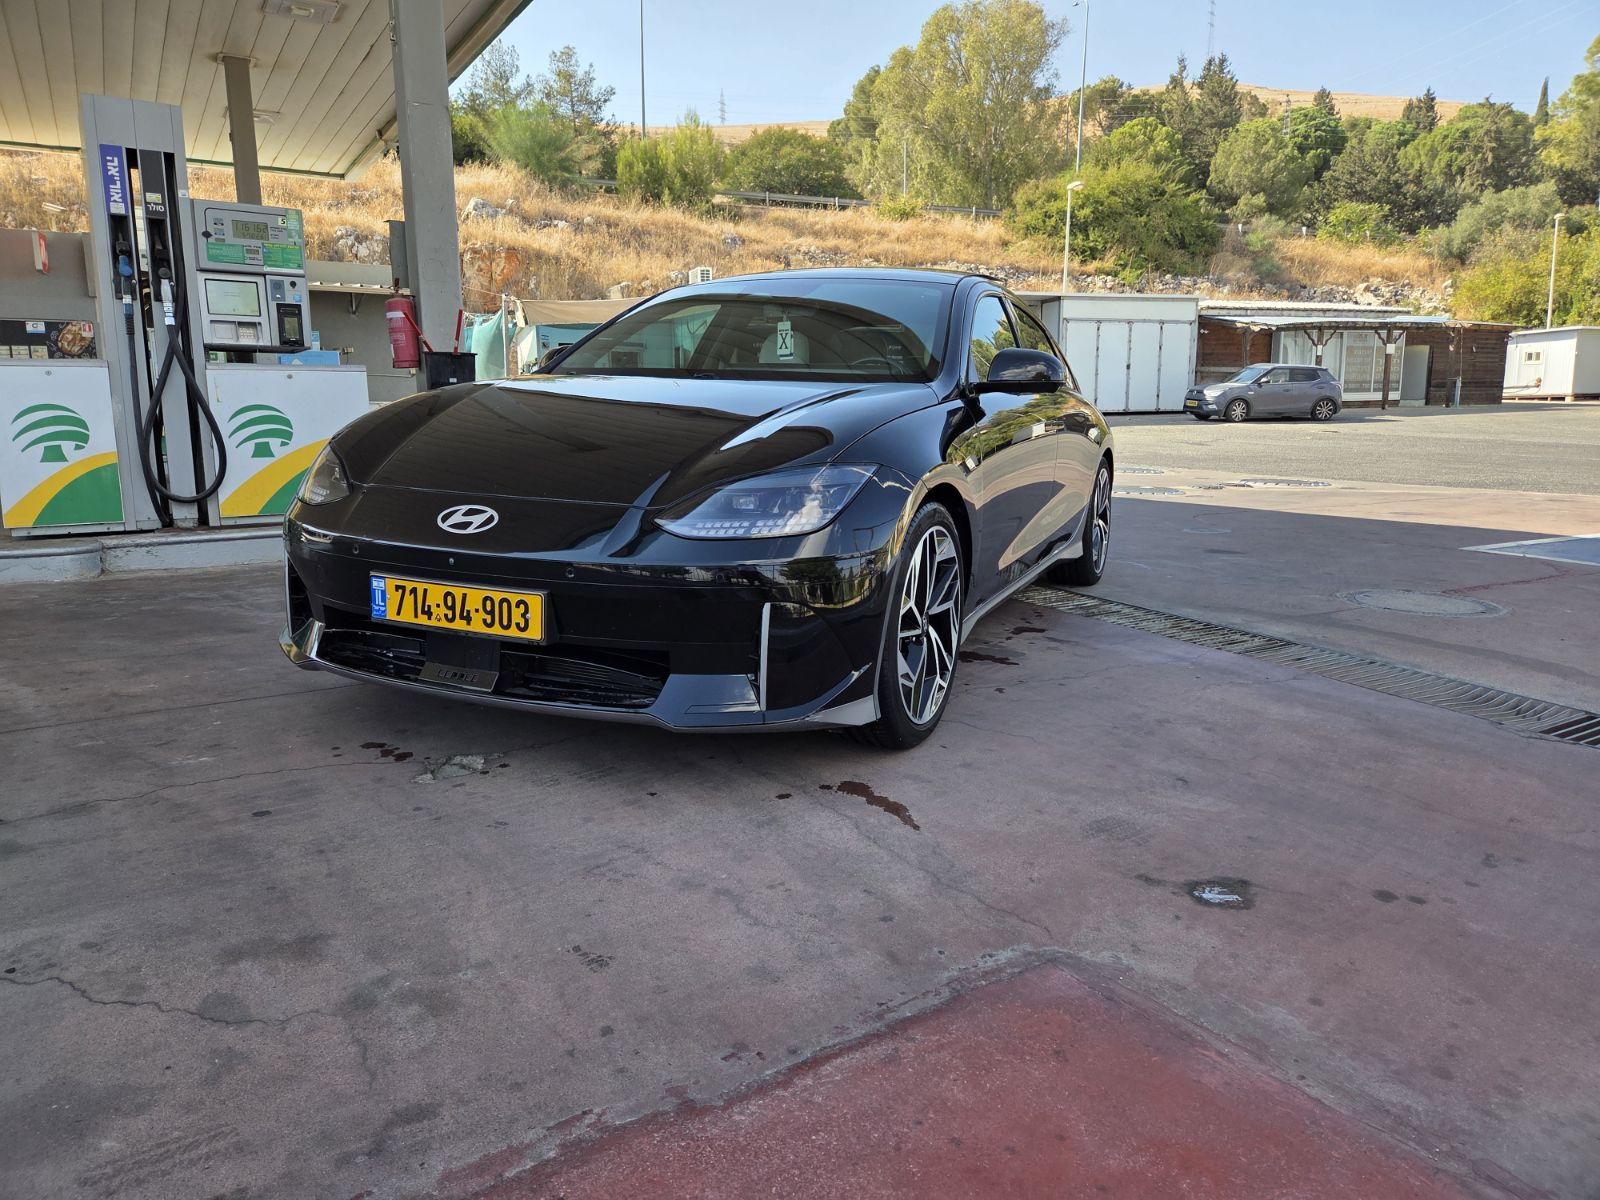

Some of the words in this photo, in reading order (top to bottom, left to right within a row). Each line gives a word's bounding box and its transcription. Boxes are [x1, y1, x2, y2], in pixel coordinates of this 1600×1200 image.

[106, 156, 122, 203] אוריאה
[147, 202, 165, 212] סולר
[779, 333, 788, 350] X
[375, 589, 385, 606] IL
